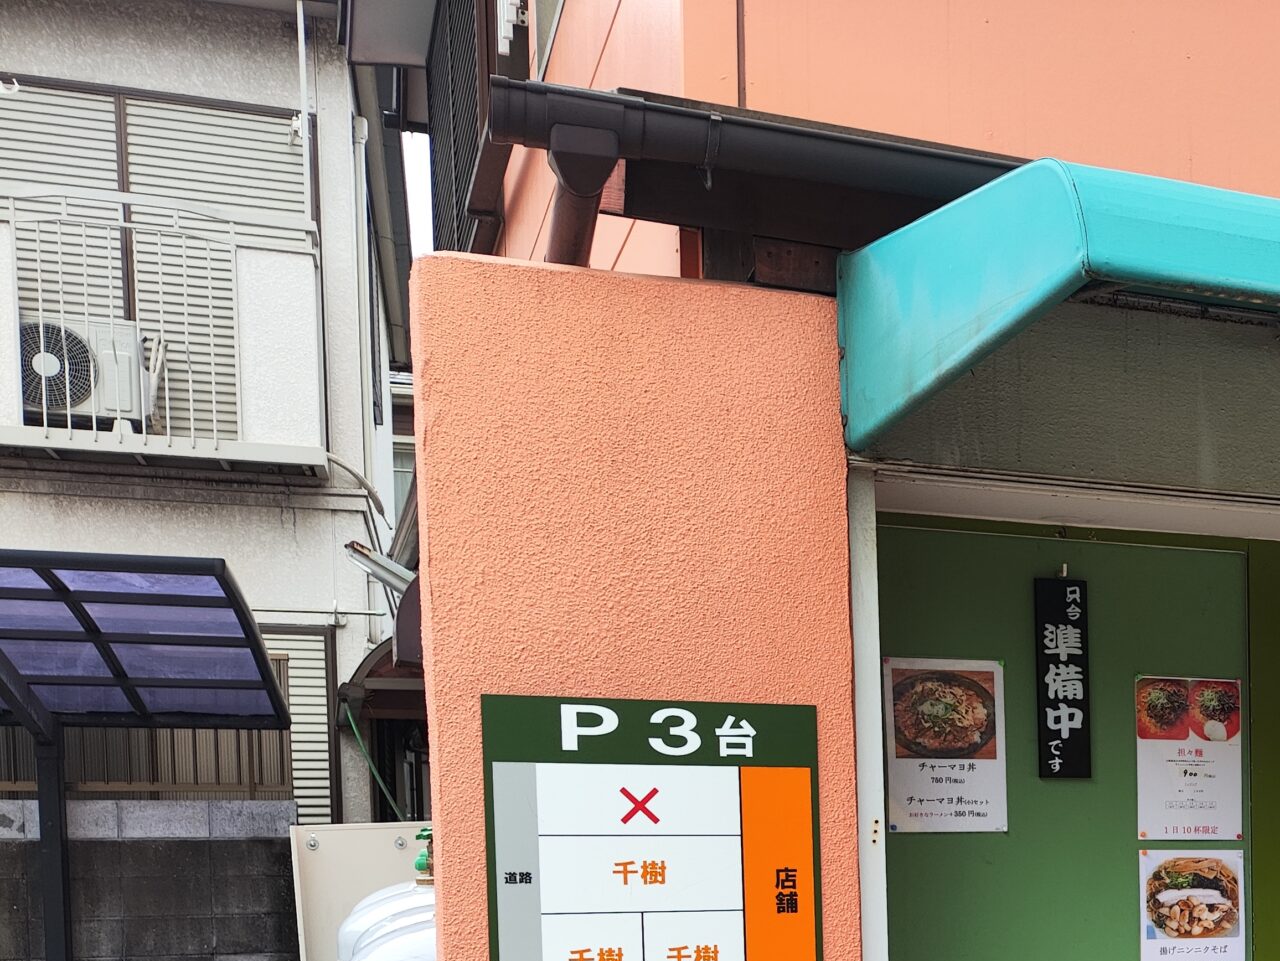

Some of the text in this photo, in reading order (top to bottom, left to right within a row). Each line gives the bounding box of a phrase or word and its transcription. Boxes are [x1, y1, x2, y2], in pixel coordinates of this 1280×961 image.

[1043, 623, 1084, 740] 準備中
[560, 703, 757, 758] P 3台
[918, 762, 977, 772] チャーマヨ丼
[504, 871, 533, 885] 道路
[612, 860, 667, 886] 千樹
[775, 867, 799, 914] 店舗
[1159, 944, 1229, 956] 揚げニンニクそば
